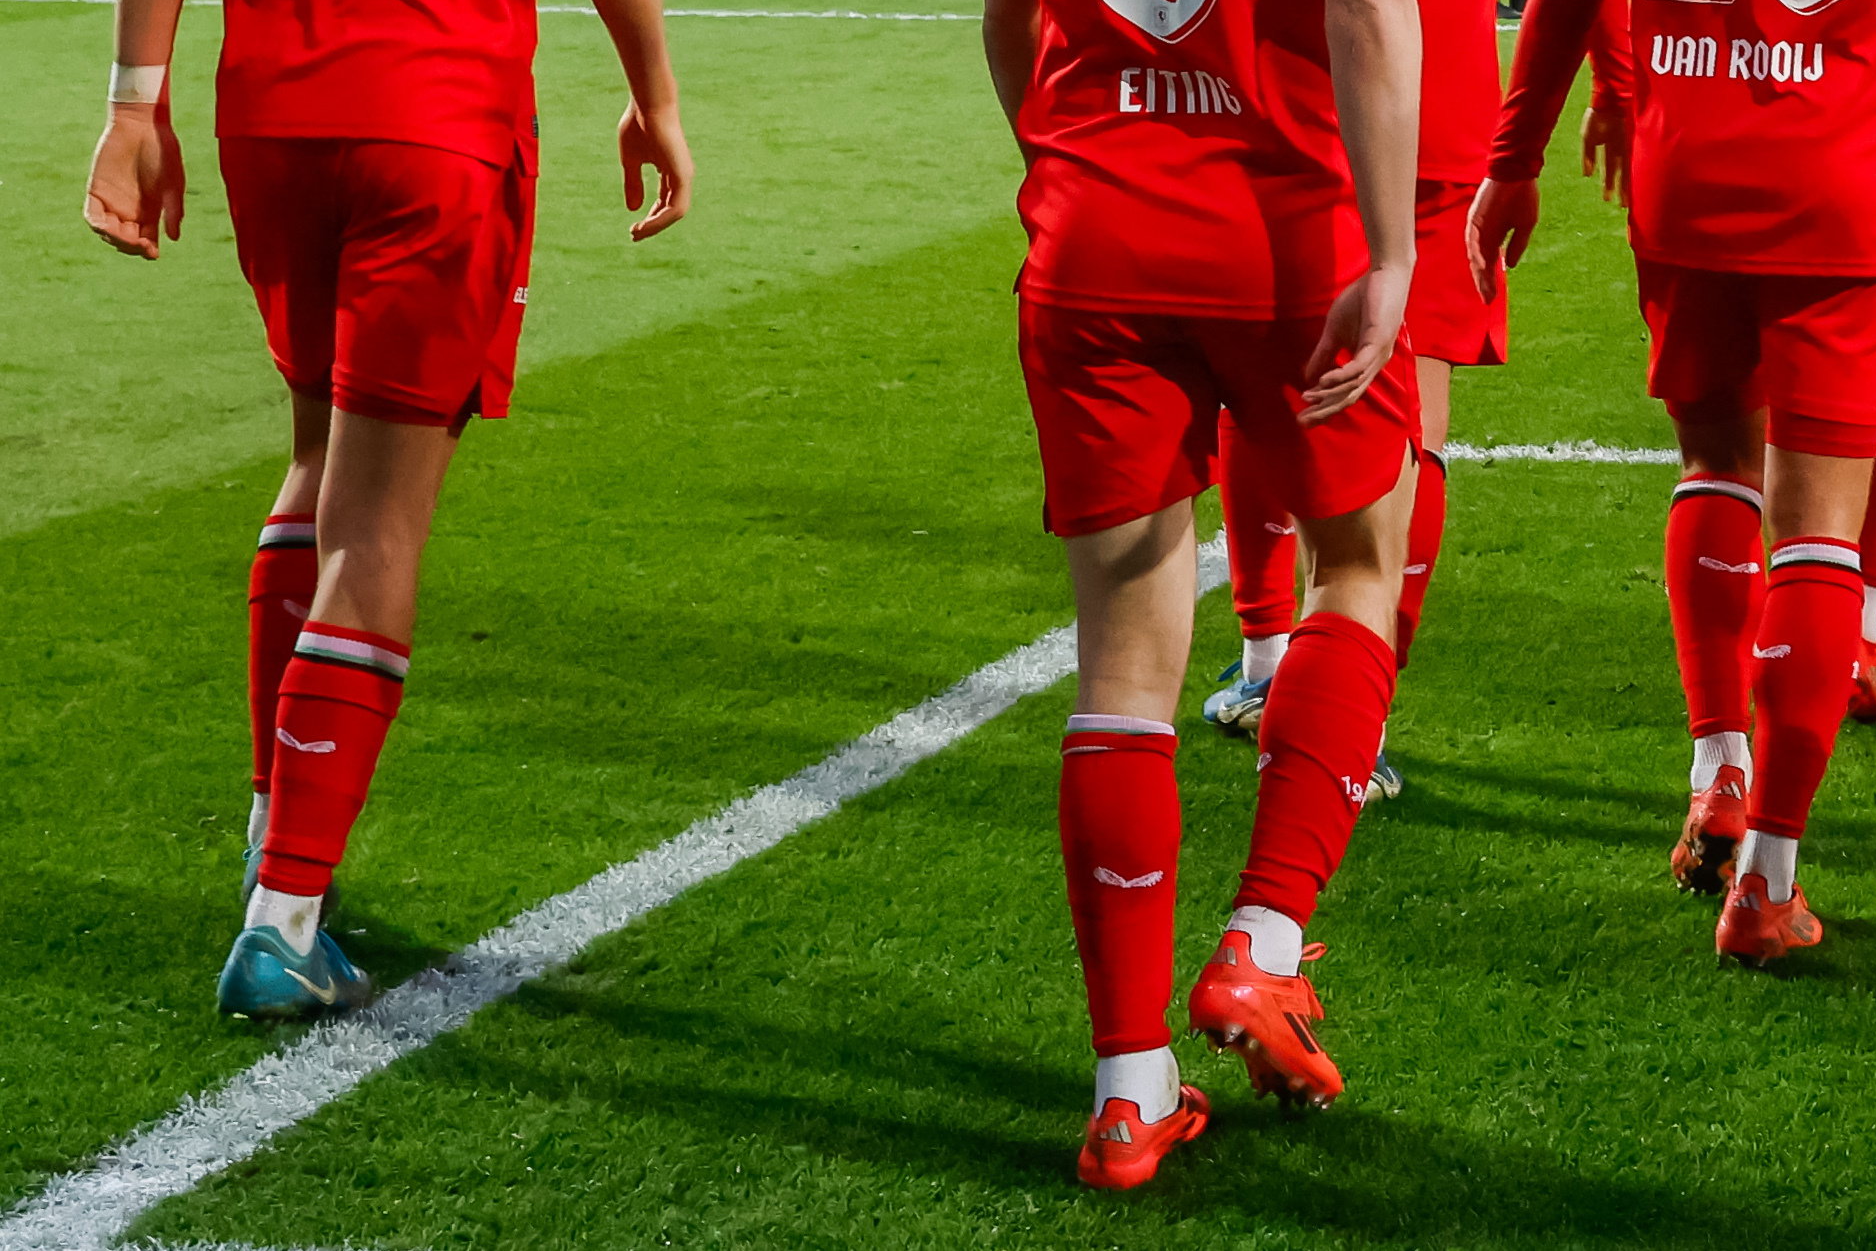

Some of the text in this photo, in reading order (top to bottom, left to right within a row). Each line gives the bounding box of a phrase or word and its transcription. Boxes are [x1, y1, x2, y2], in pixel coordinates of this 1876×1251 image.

[1650, 35, 1825, 83] VAN ROOIJ
[1119, 67, 1242, 116] EITING
